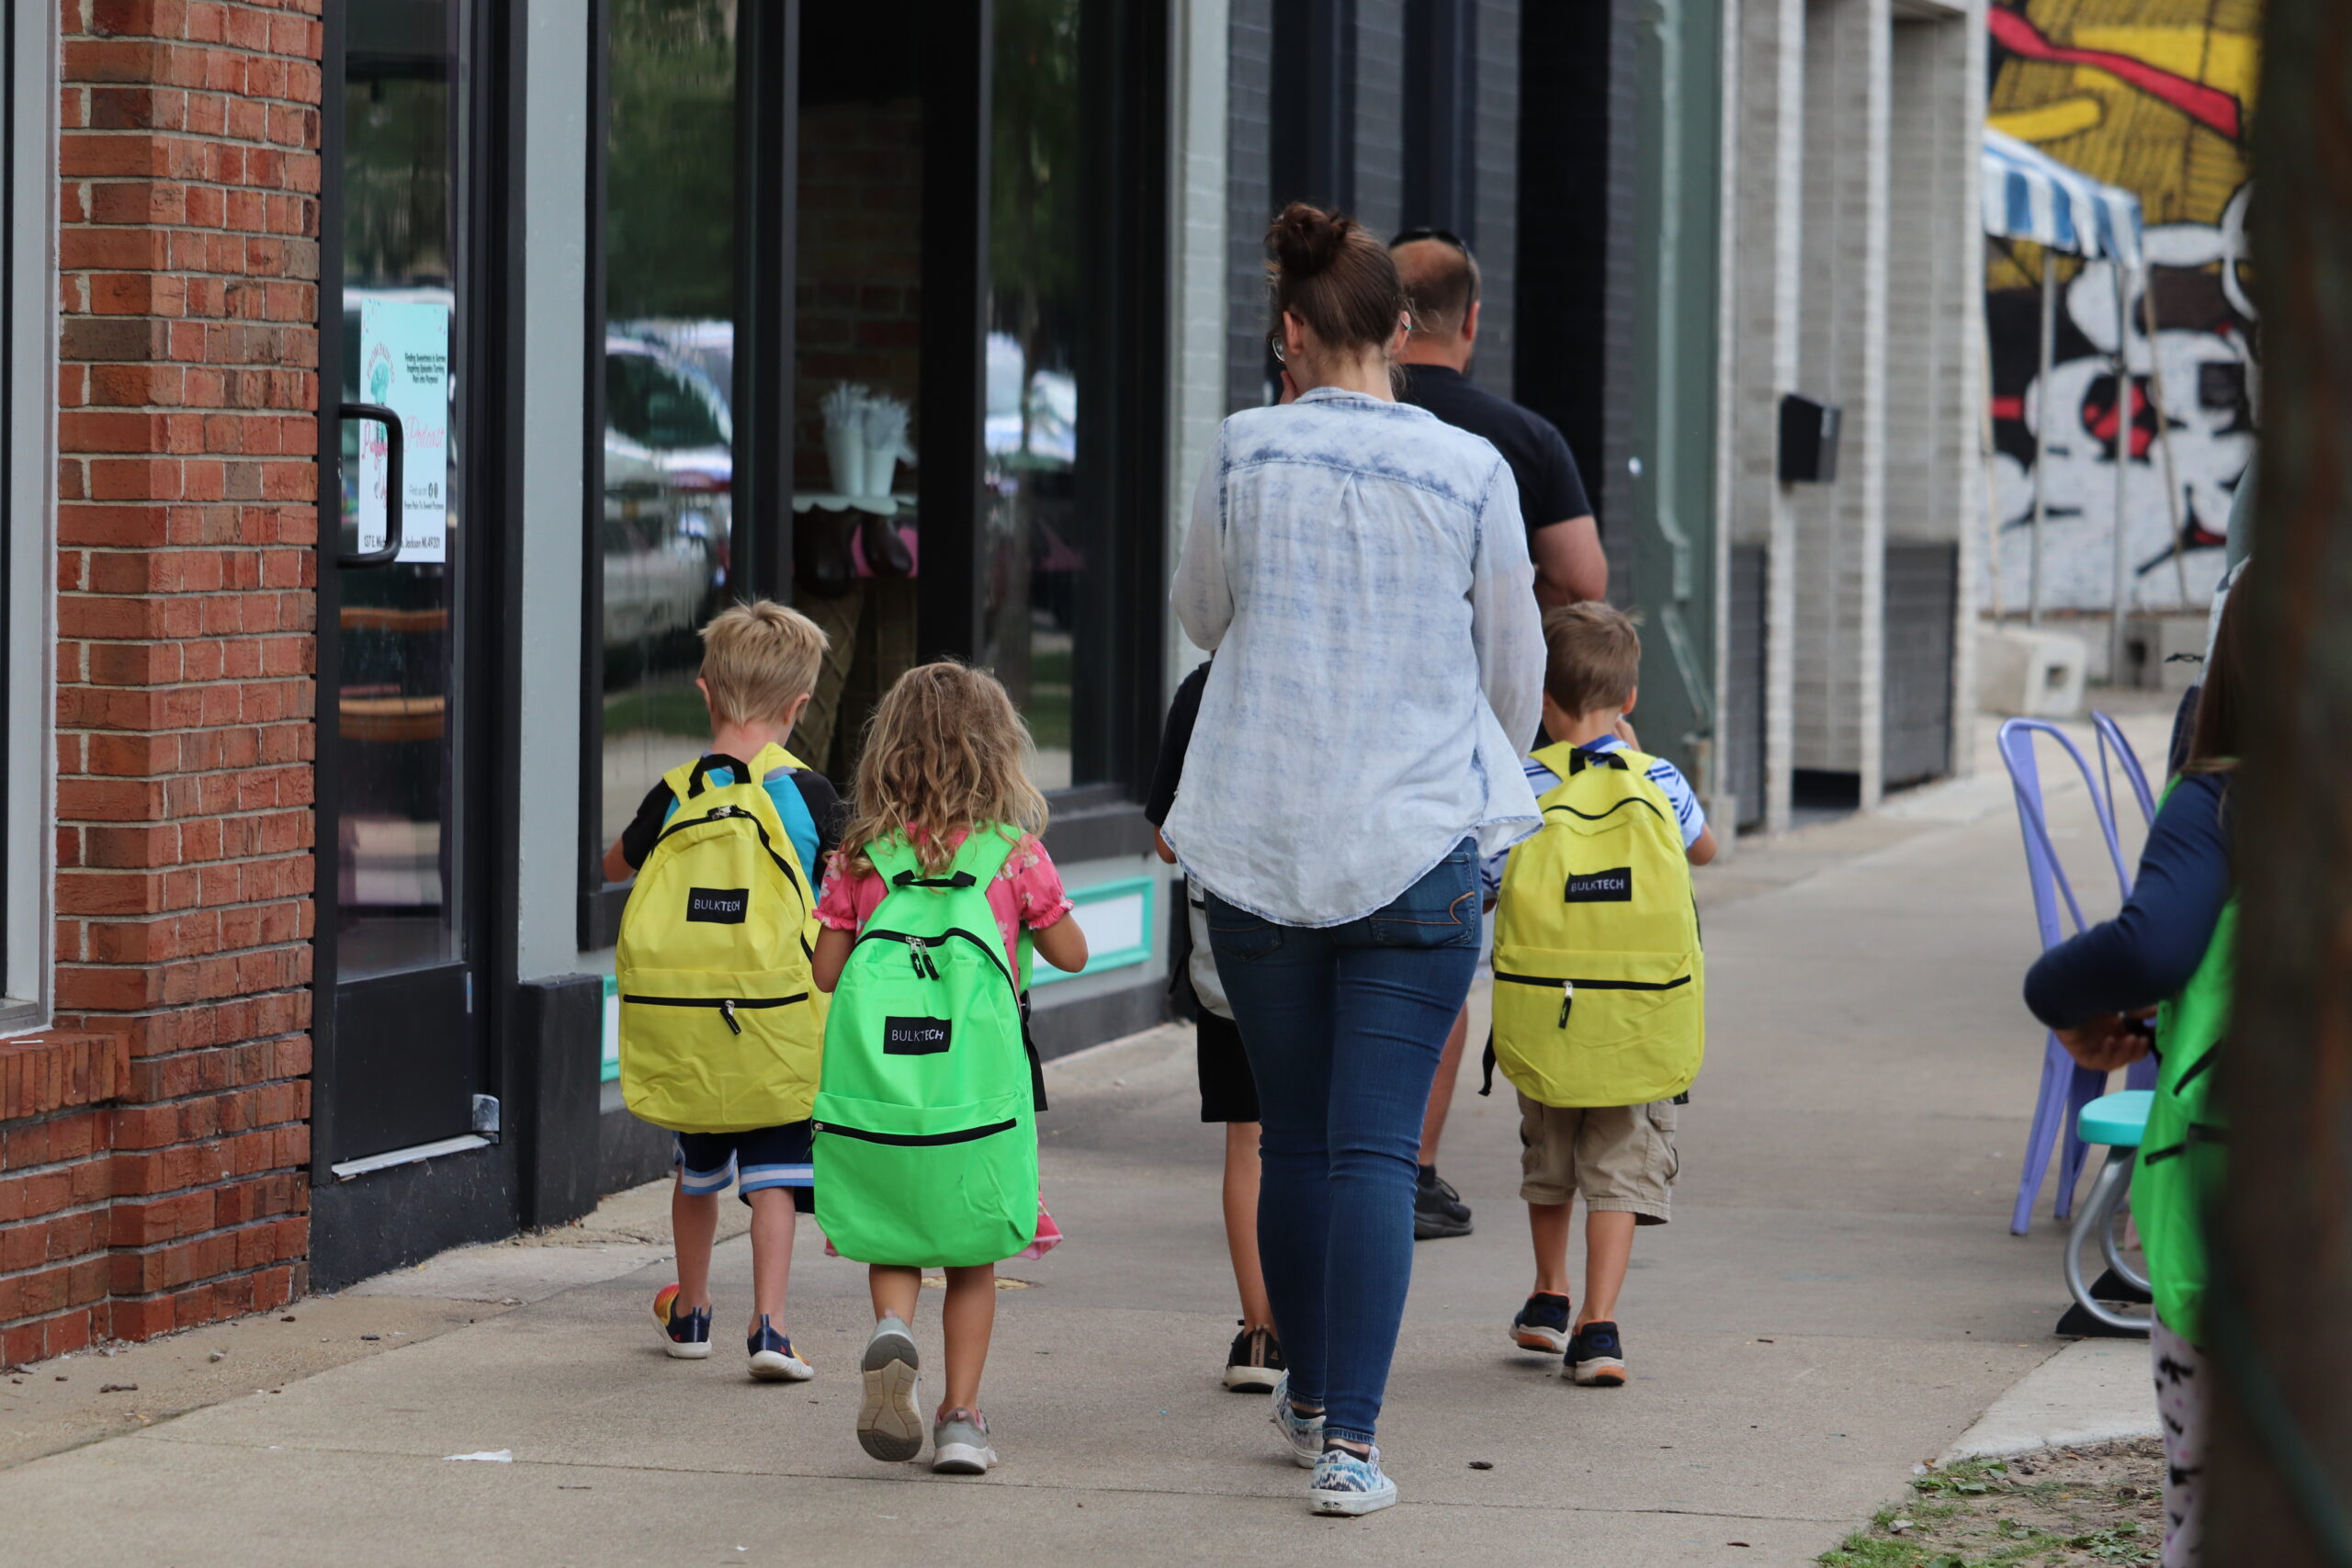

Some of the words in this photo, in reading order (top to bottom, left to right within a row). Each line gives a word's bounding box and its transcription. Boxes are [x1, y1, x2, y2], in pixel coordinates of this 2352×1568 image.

[403, 416, 445, 452] Podcast
[1571, 878, 1624, 892] BULKTECH
[694, 898, 741, 912] BULKTECH
[891, 1029, 944, 1042] BULKTECH
